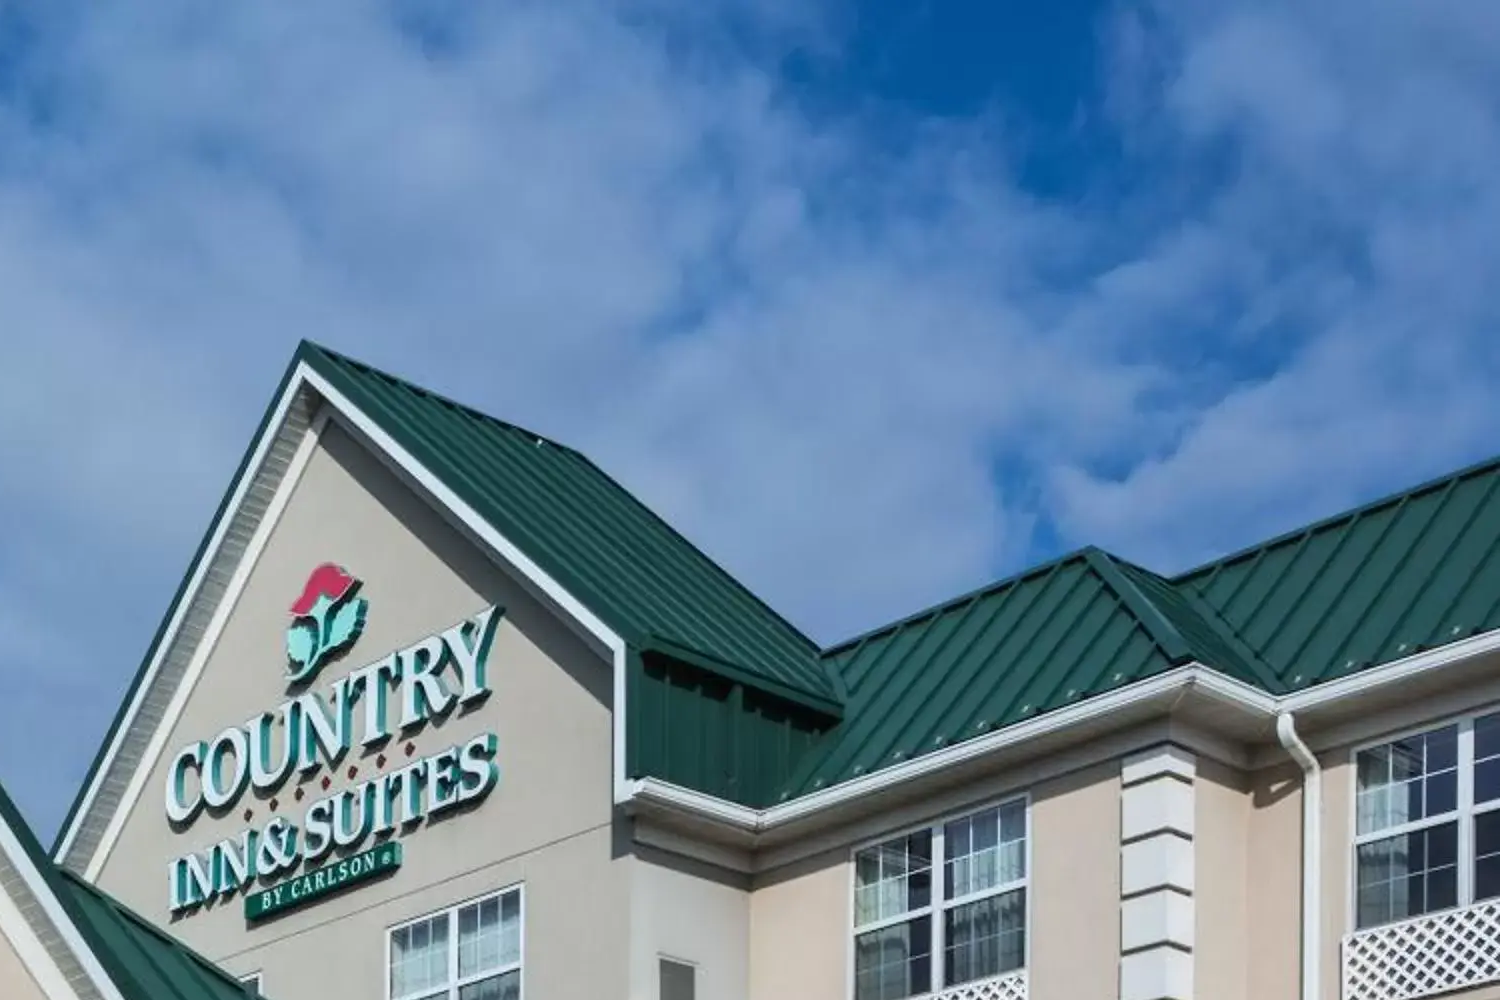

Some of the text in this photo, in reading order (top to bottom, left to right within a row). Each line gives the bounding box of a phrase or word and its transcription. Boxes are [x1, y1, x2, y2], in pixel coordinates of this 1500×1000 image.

[165, 605, 503, 823] COUNTRY
[261, 851, 376, 911] BY CARLSON
